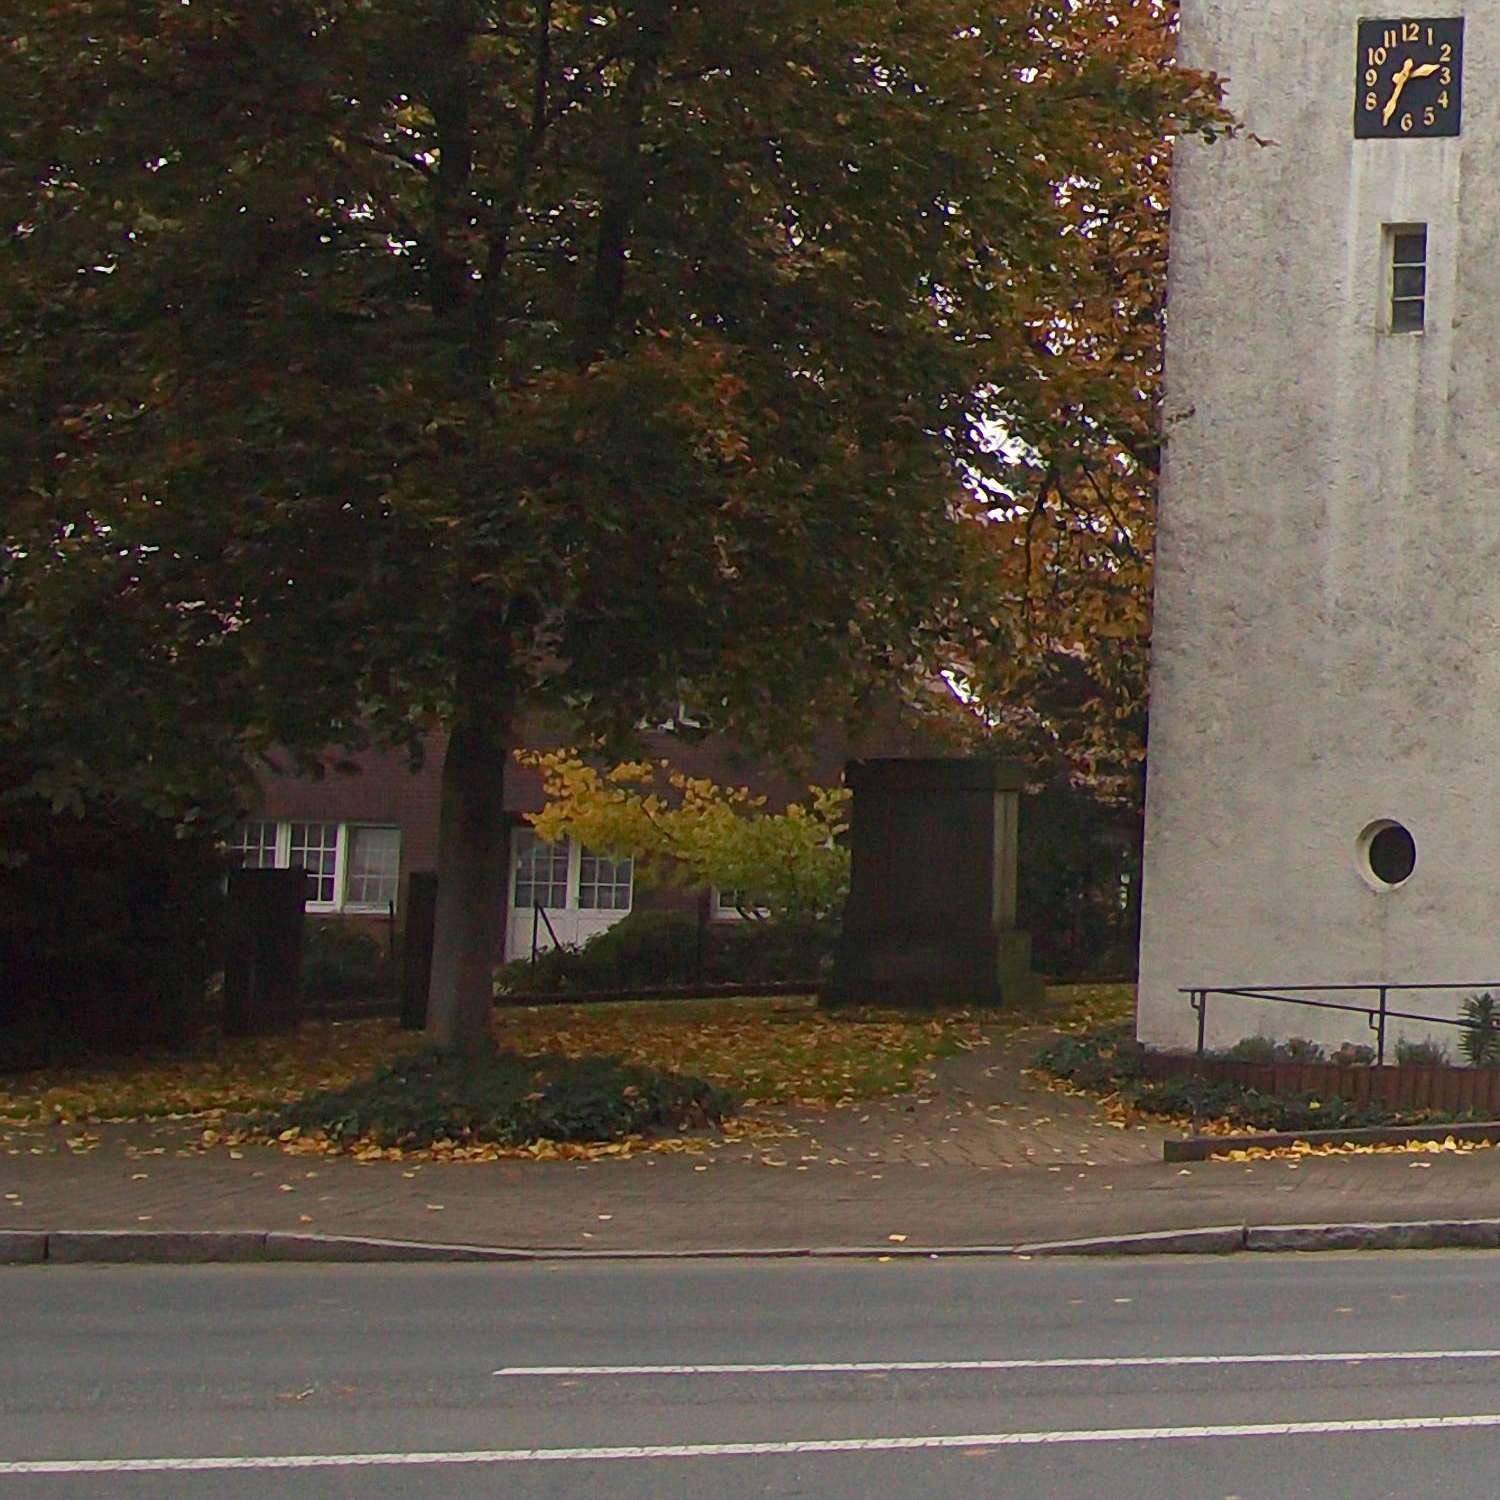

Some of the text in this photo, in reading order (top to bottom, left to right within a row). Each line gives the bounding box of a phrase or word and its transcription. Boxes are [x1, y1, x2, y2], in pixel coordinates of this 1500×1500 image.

[1384, 30, 1397, 48] 11
[1402, 23, 1420, 41] 12
[1427, 28, 1433, 45] 1
[1368, 47, 1387, 66] 10
[1440, 43, 1452, 62] 2
[1365, 69, 1378, 87] 9
[1440, 67, 1451, 85] 3
[1365, 92, 1377, 111] 8
[1437, 90, 1449, 108] 4
[1401, 113, 1413, 132] 6
[1423, 107, 1435, 125] 5
